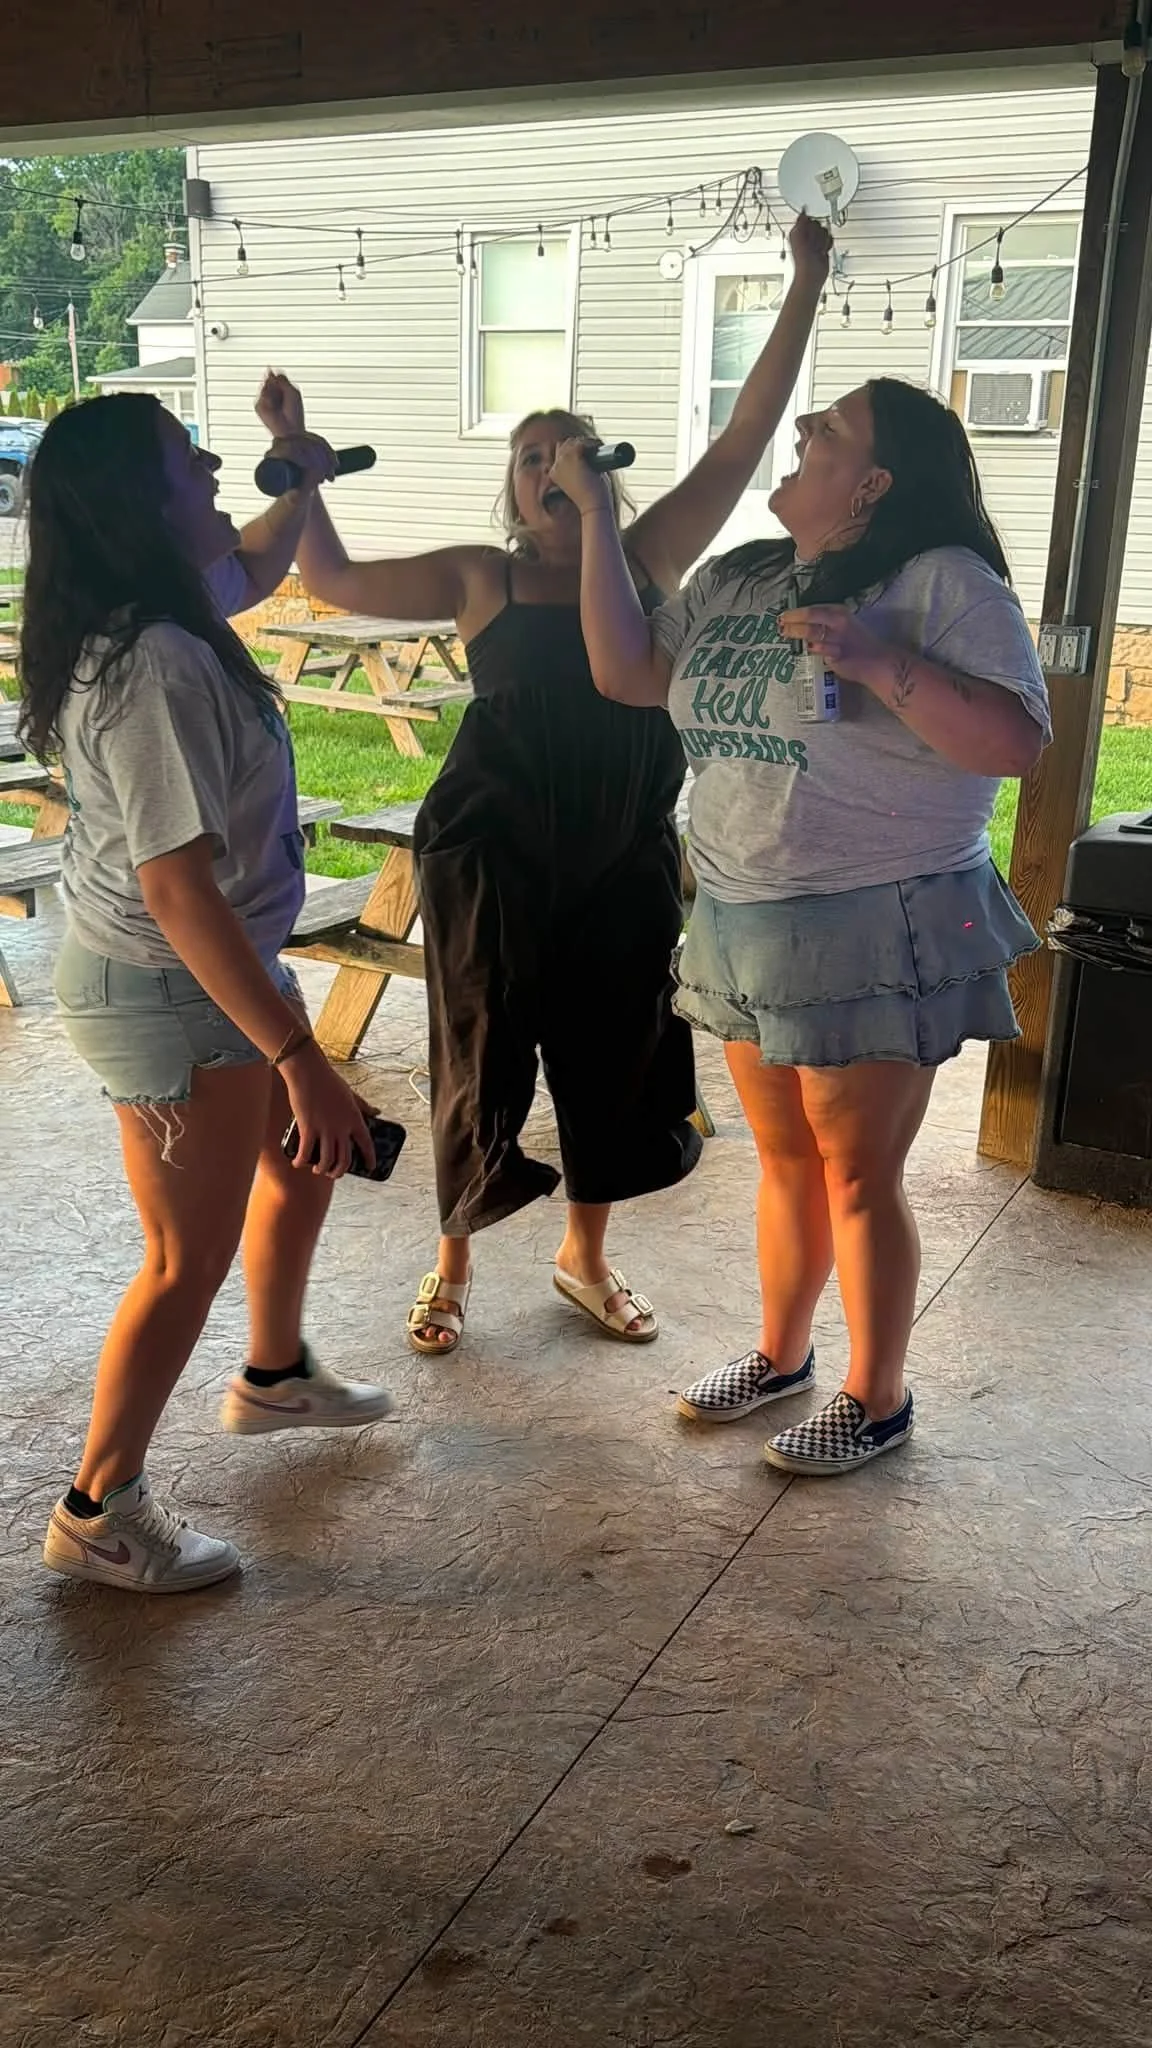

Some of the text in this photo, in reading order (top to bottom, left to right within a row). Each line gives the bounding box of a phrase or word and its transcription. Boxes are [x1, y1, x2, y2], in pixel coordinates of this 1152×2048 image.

[680, 647, 796, 684] RAISING
[691, 678, 770, 729] Hell
[680, 728, 808, 772] UPSTAIRS
